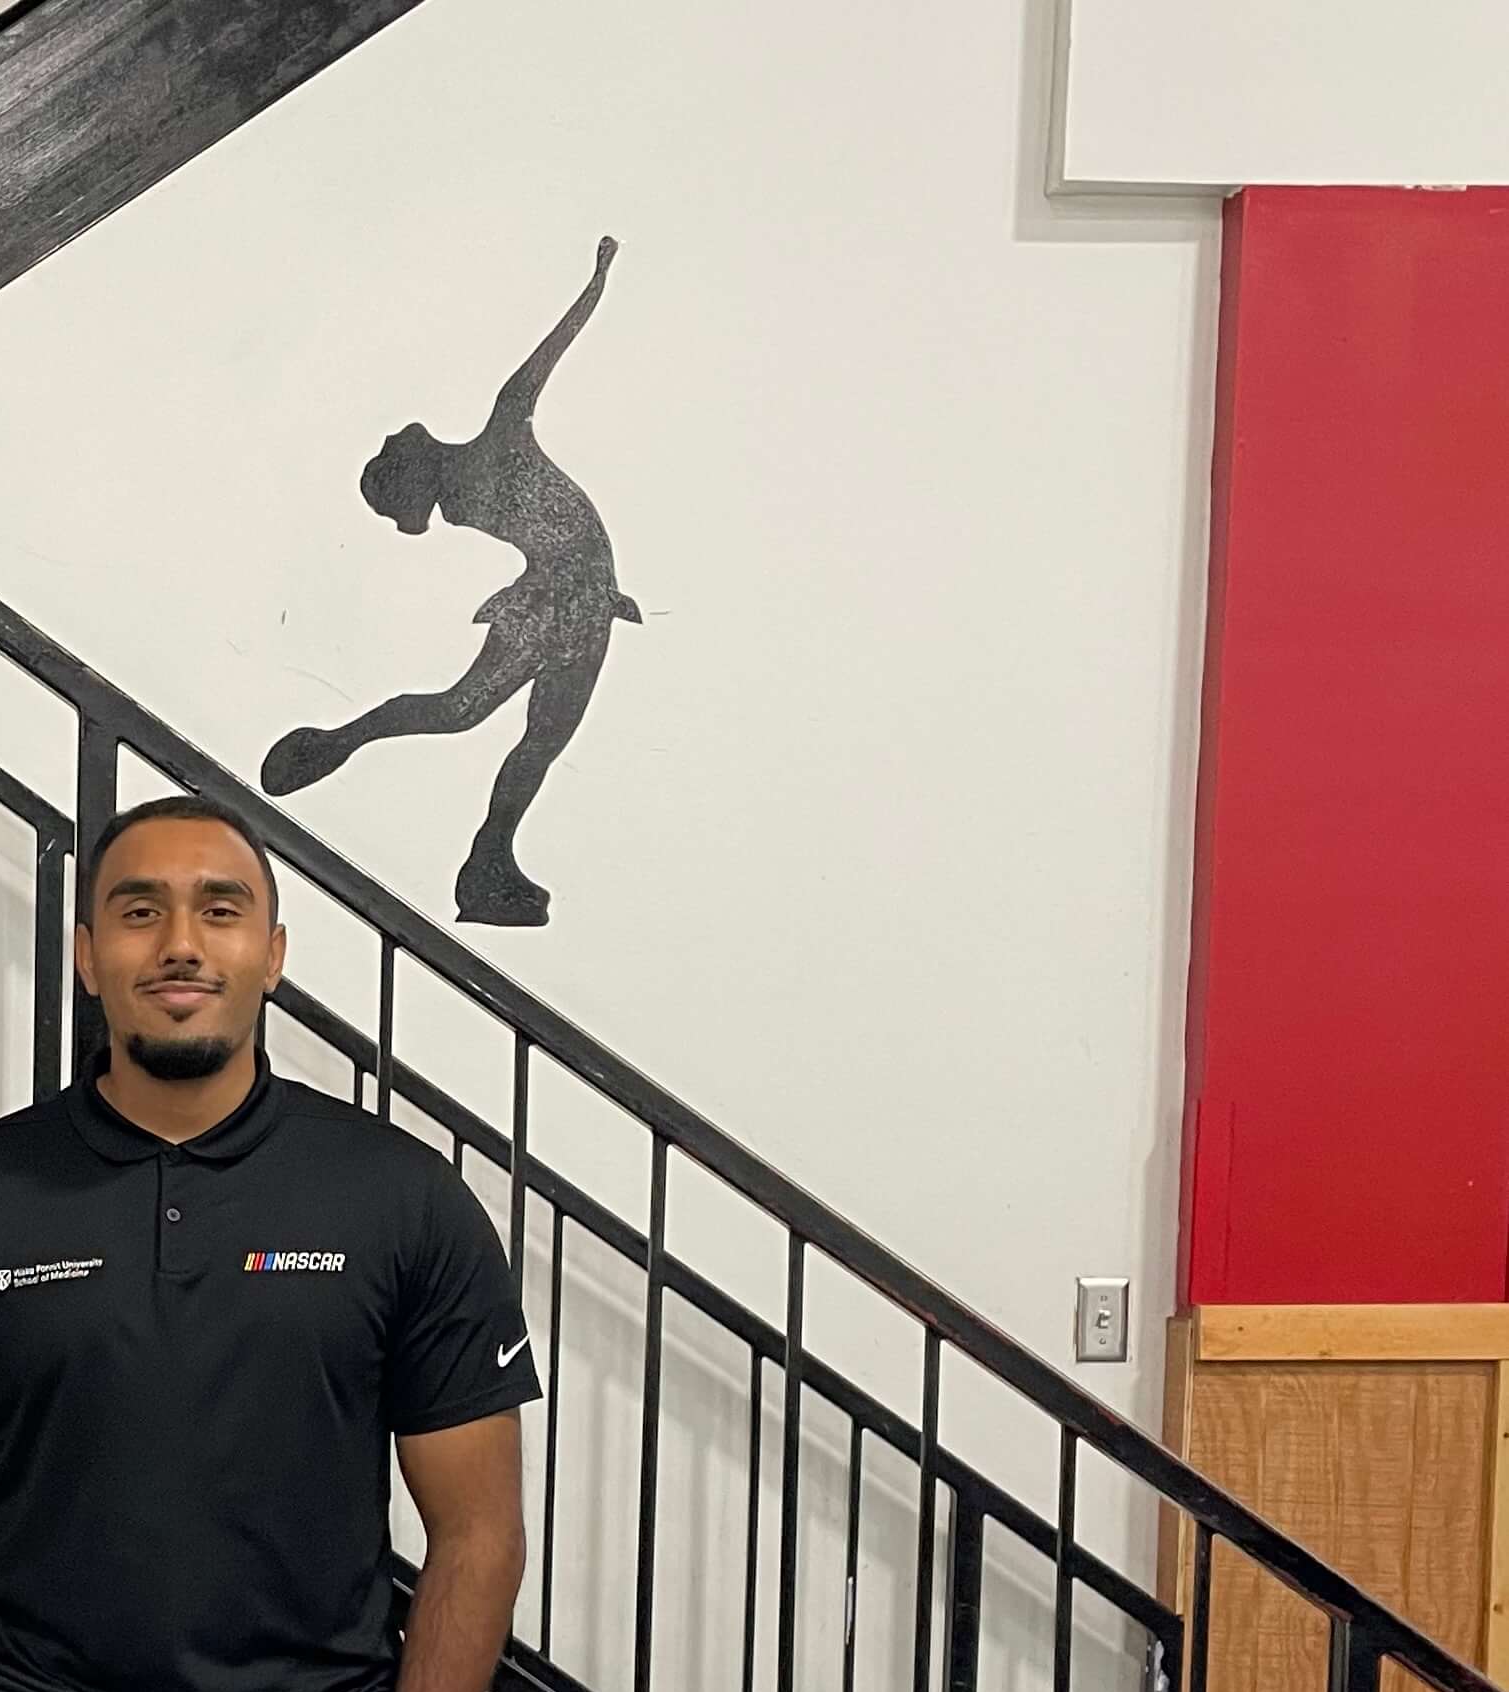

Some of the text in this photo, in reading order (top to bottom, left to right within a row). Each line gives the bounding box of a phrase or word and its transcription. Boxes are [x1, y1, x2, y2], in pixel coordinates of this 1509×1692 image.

[36, 1262, 61, 1274] Forest
[61, 1258, 104, 1271] University
[272, 1251, 346, 1272] NASCAR
[13, 1269, 90, 1289] School of Medicine
